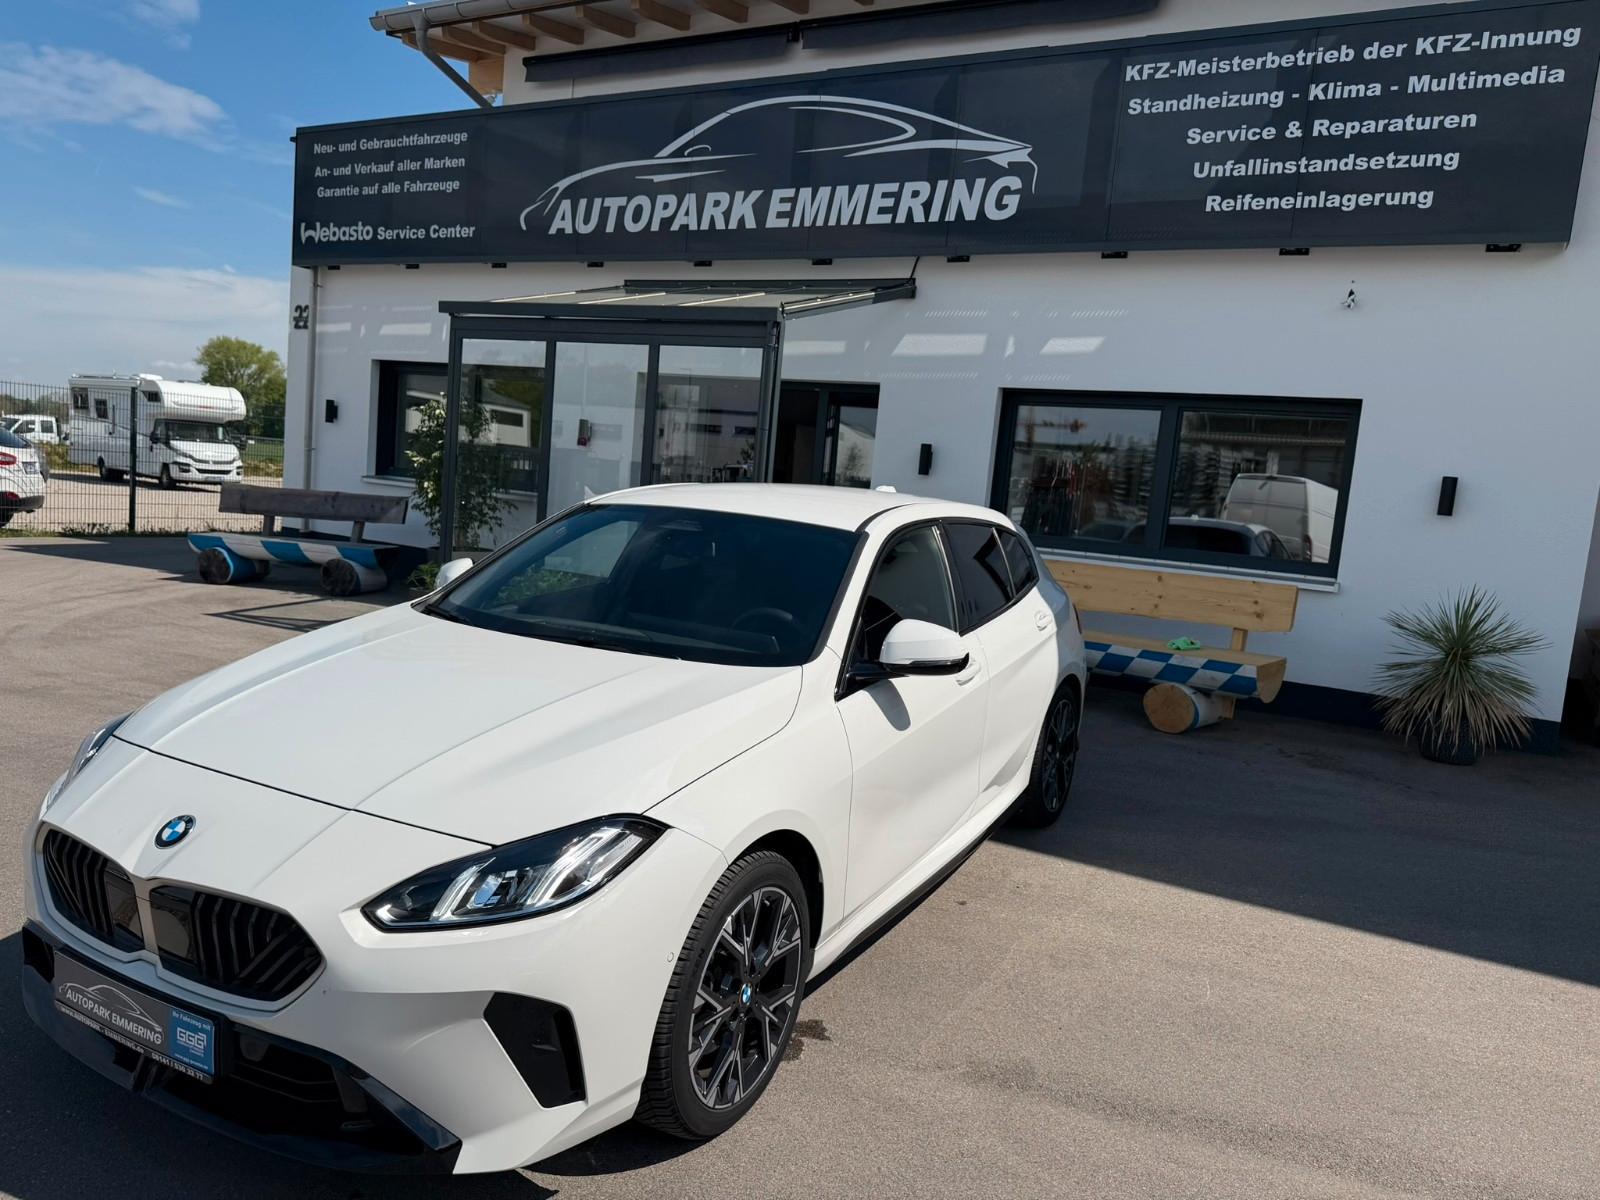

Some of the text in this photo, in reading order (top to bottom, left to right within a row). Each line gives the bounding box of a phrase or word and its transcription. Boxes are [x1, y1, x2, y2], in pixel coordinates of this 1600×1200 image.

[1125, 26, 1581, 81] KFZ-Meisterbetrieb der KFZ-Innung
[1128, 90, 1284, 115] Standheizung
[1309, 81, 1382, 100] Klima
[1407, 65, 1566, 94] Multimedia
[1186, 113, 1477, 144] Service & Reparaturen
[314, 132, 468, 154] Neu- und Gebrauchtfahrzeuge
[314, 157, 465, 178] An- und Verkauf aller Marken
[1193, 151, 1460, 178] Unfallinstandsetzung
[317, 180, 460, 198] Garantie auf alle Fahrzeuge
[1205, 190, 1434, 212] Reifeneinlagerung
[548, 176, 1023, 235] AUTOPARK EMMERING
[300, 221, 475, 244] Webasto Service Center
[66, 988, 162, 1044] AUTOPARK EMMERING
